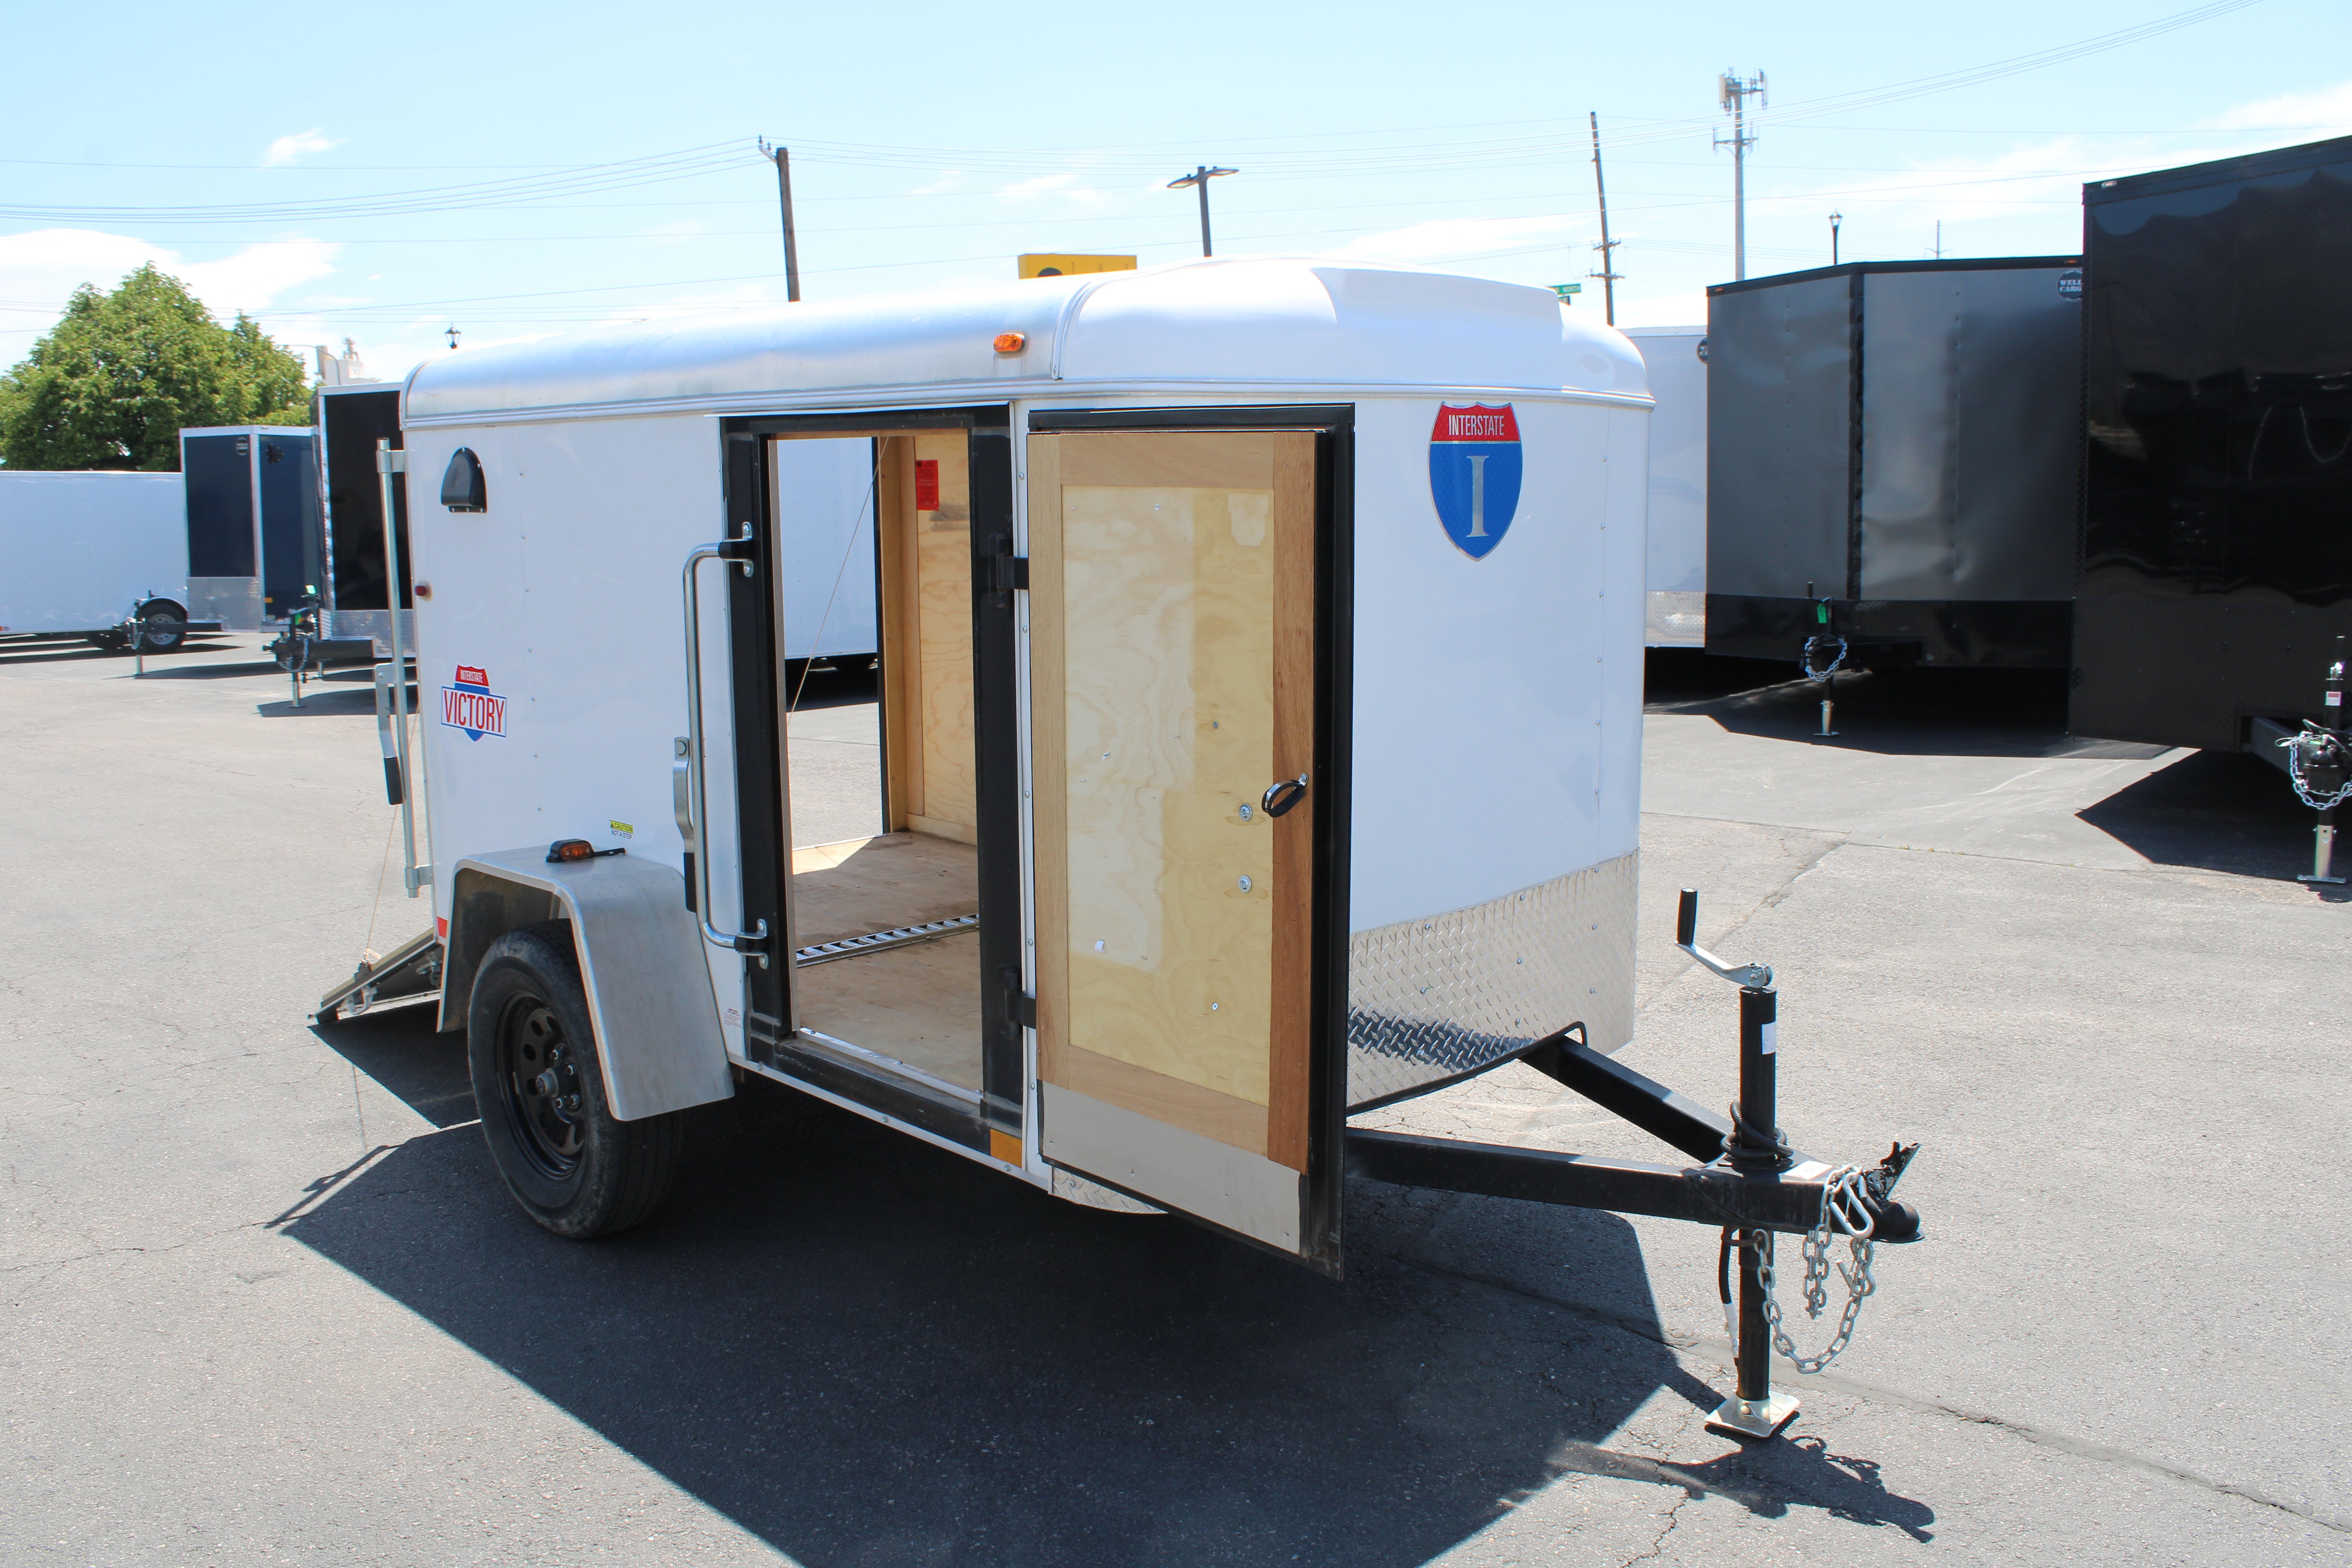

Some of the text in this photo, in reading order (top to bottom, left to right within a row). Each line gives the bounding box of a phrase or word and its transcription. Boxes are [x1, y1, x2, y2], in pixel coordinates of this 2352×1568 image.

[1449, 415, 1504, 436] INTERSTATE
[1466, 455, 1490, 538] I
[460, 669, 483, 683] INTERSTATE
[444, 690, 505, 733] VICTORY
[614, 822, 633, 833] CAUTION
